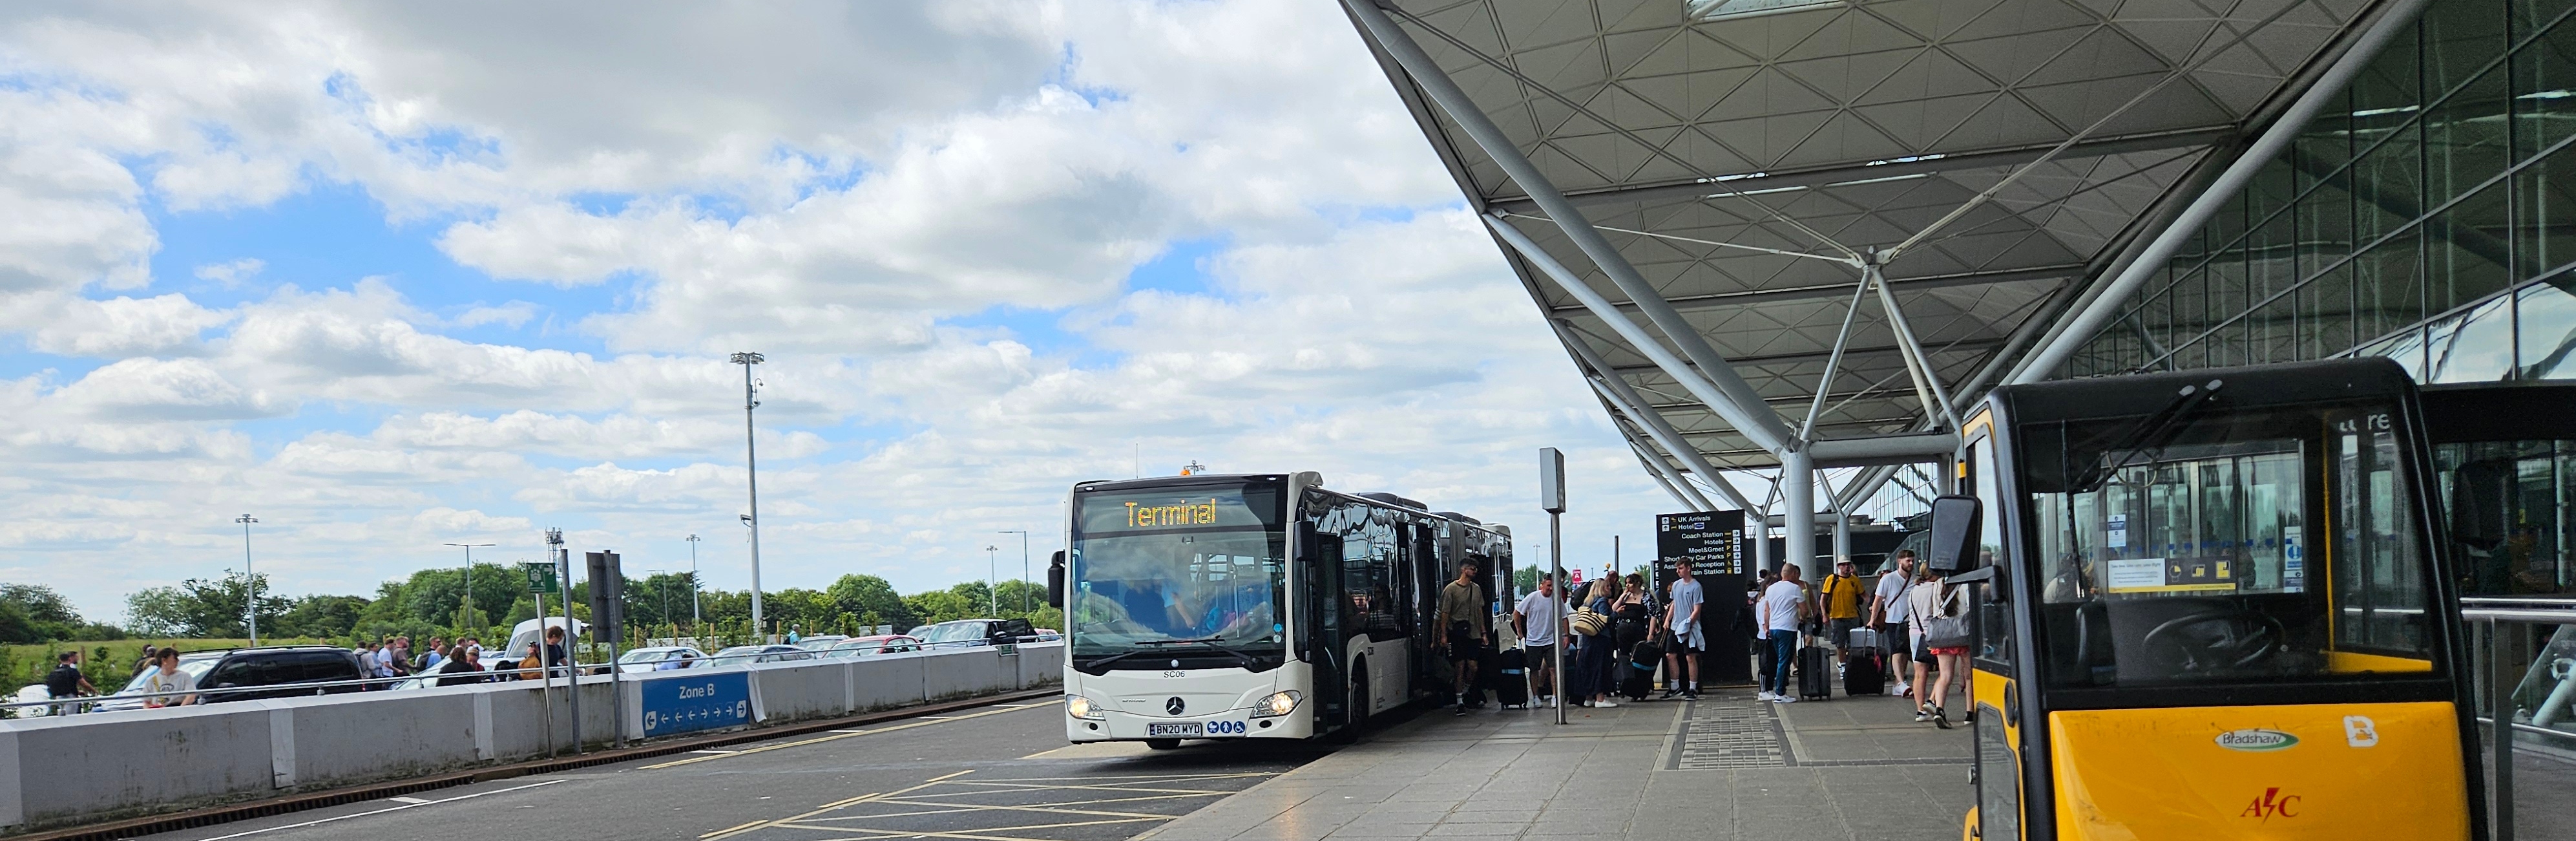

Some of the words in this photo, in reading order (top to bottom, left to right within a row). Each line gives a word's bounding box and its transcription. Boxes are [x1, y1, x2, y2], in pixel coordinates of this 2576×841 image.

[1125, 498, 1216, 527] Terminal
[679, 686, 705, 699] Zone
[707, 683, 715, 696] B
[1157, 725, 1180, 734] BN20
[1182, 725, 1200, 734] MYD
[2343, 715, 2379, 747] B
[2223, 734, 2281, 744] Bradshaw
